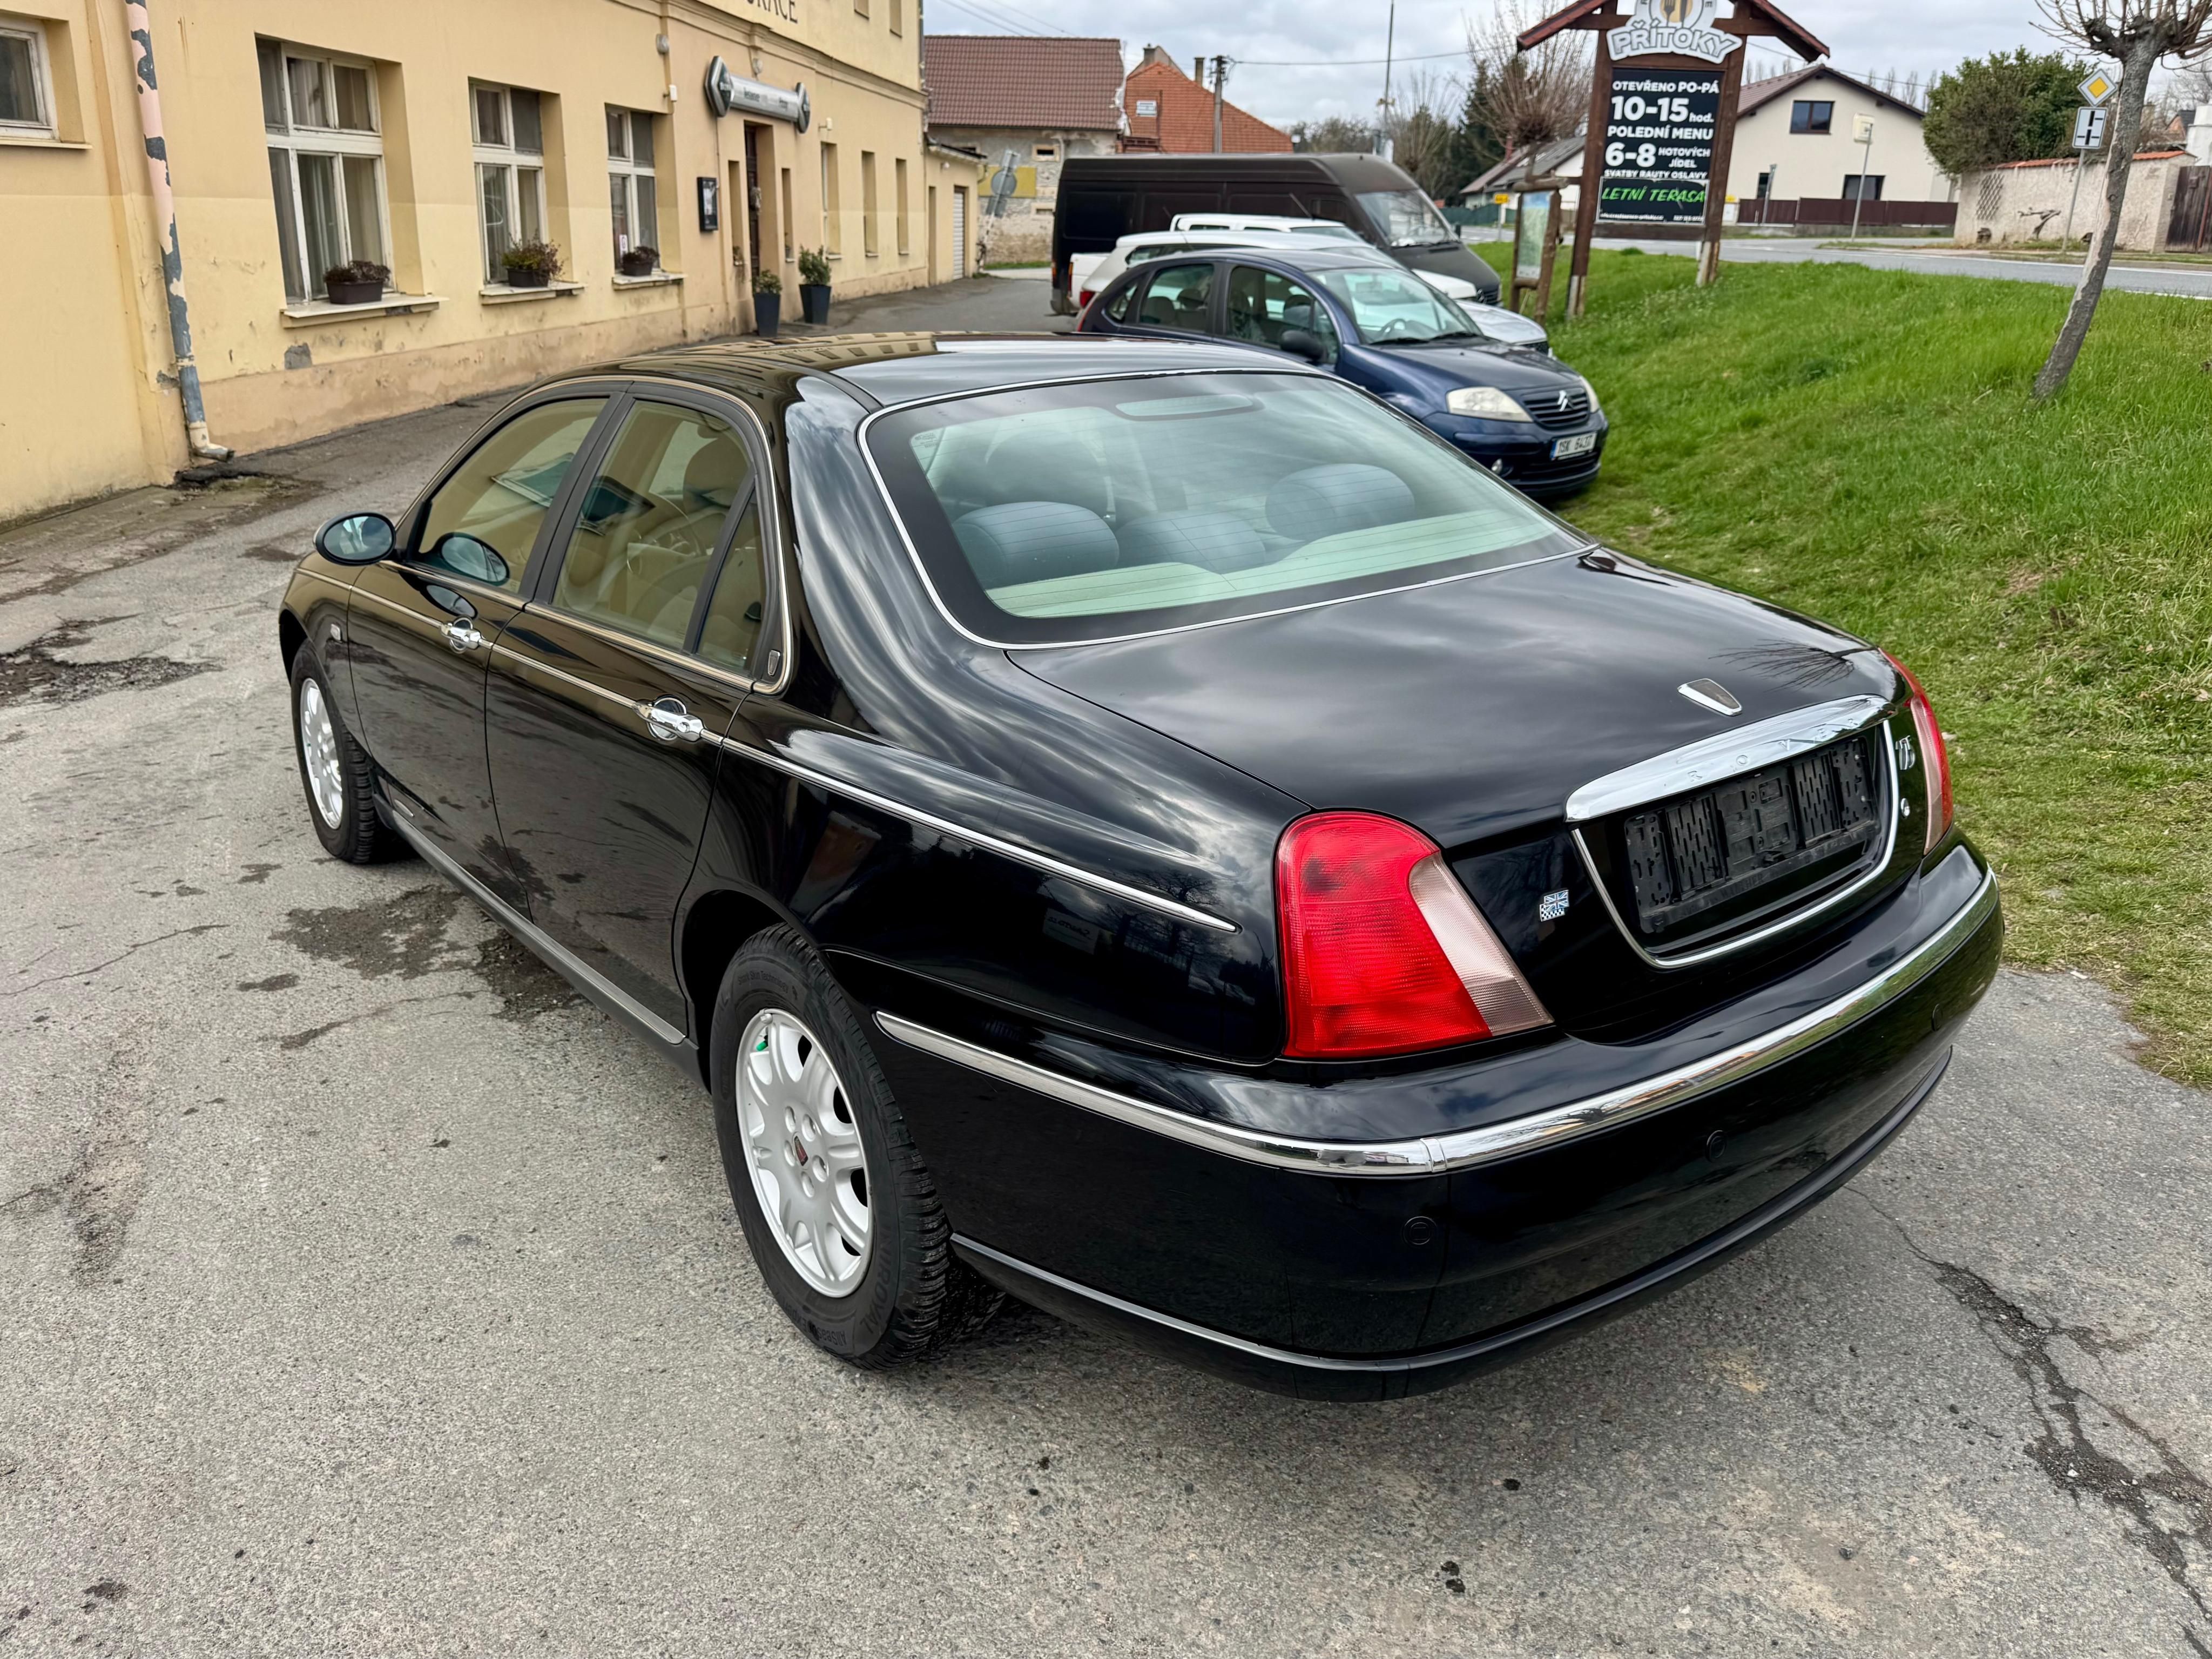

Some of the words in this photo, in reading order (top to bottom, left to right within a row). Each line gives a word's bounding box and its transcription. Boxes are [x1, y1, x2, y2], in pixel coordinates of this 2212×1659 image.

[1611, 18, 1736, 58] PŘÍTOKY
[1612, 79, 1676, 92] OTEVŘENO
[1678, 80, 1719, 93] PO-PÁ
[1611, 96, 1689, 122] 10-15
[1689, 112, 1714, 123] hod.
[1607, 124, 1671, 138] POLEDNÍ
[1671, 127, 1714, 140] MENU
[1605, 141, 1656, 167] 6-8
[1658, 146, 1711, 157] HOTOVÝCH
[1669, 157, 1697, 168] JÍDEL
[1604, 169, 1639, 177] SVATBY
[1639, 170, 1670, 178] RAUTY
[1671, 171, 1708, 179] OSLAVY
[1602, 186, 1648, 200] LETNÍ
[1649, 189, 1705, 203] TERASA
[1687, 718, 1858, 783] ROVER
